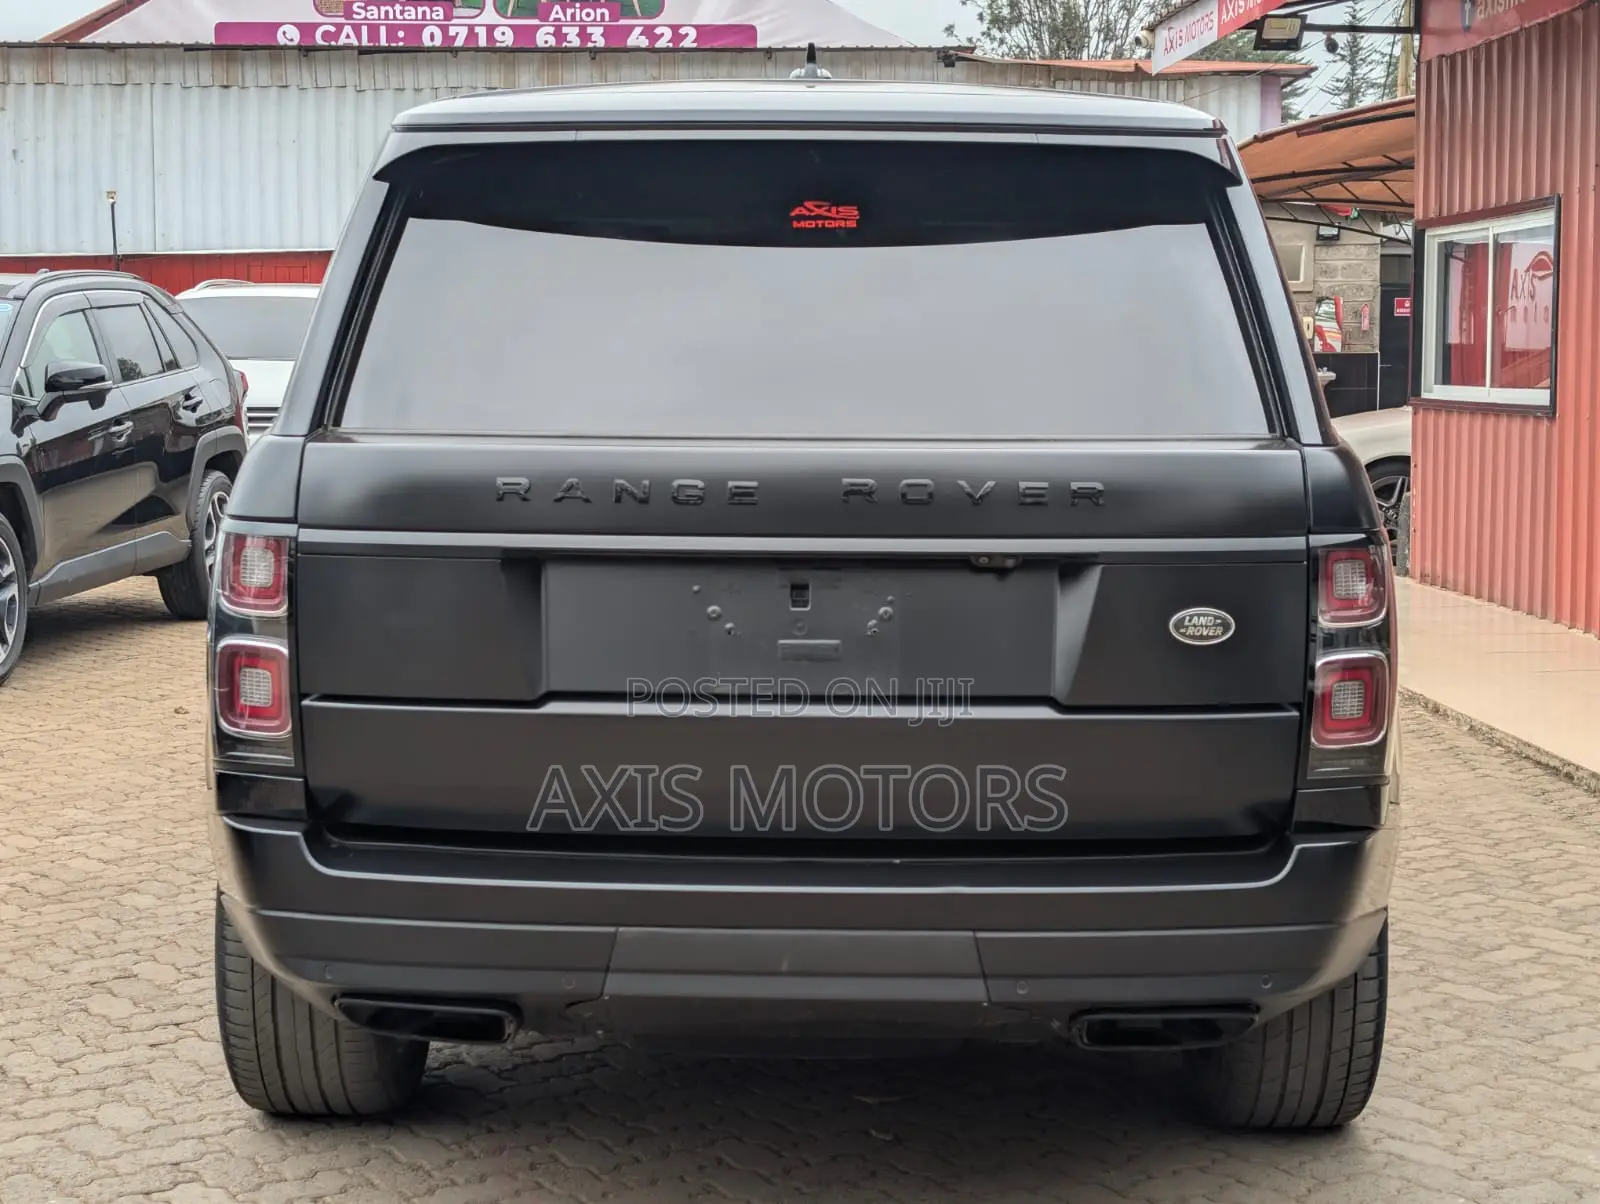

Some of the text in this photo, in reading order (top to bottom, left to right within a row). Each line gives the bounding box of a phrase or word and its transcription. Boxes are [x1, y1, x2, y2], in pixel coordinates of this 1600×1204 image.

[352, 2, 445, 20] Santana
[549, 4, 610, 22] Arion
[315, 24, 698, 47] CALL: 0719 633 422
[1163, 11, 1214, 56] AXIS MOTORS
[789, 200, 860, 219] AXIS
[792, 220, 857, 229] MOTORS
[1510, 267, 1535, 301] AXIS
[496, 476, 1105, 506] RANGE ROVER
